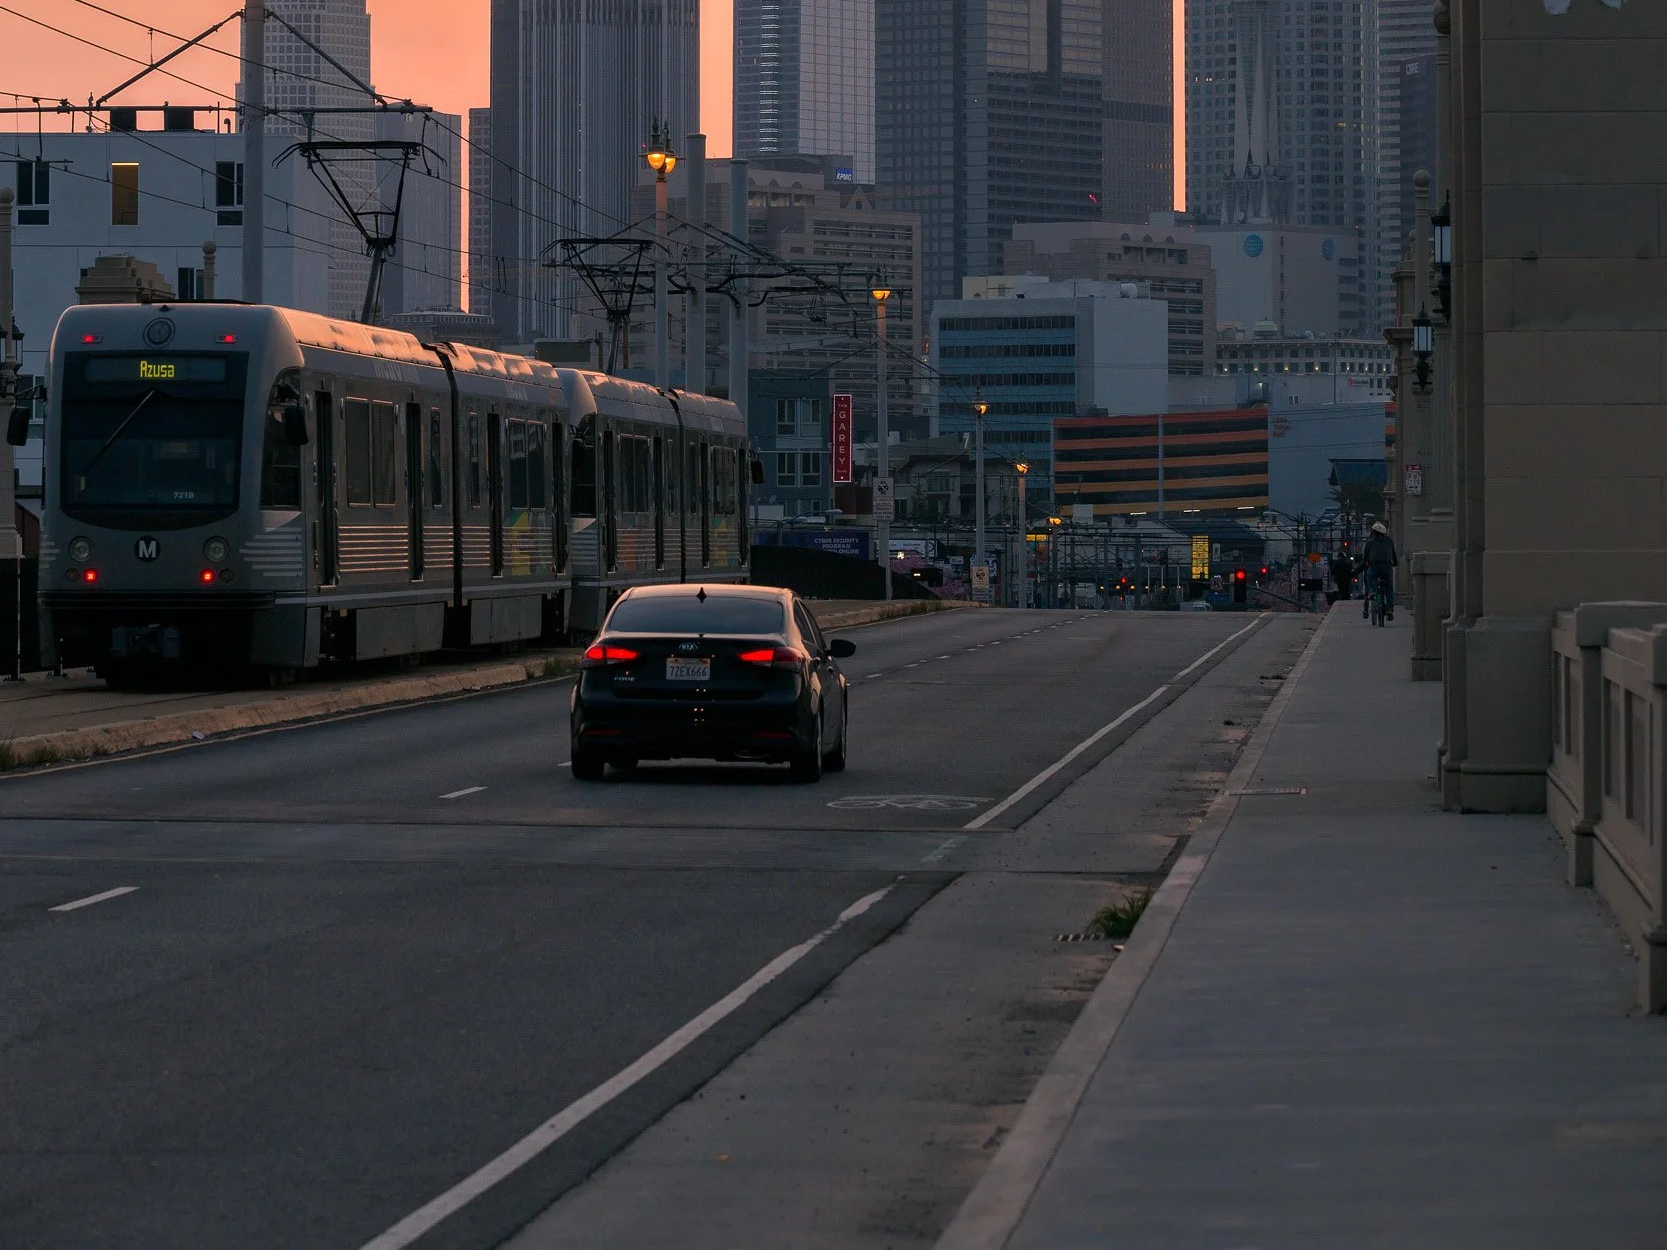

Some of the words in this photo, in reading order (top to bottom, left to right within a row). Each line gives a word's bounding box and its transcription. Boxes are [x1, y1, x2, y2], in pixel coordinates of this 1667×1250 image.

[140, 360, 175, 378] Azusa
[838, 411, 846, 465] GAREY
[138, 540, 157, 558] M
[681, 643, 695, 651] KIA
